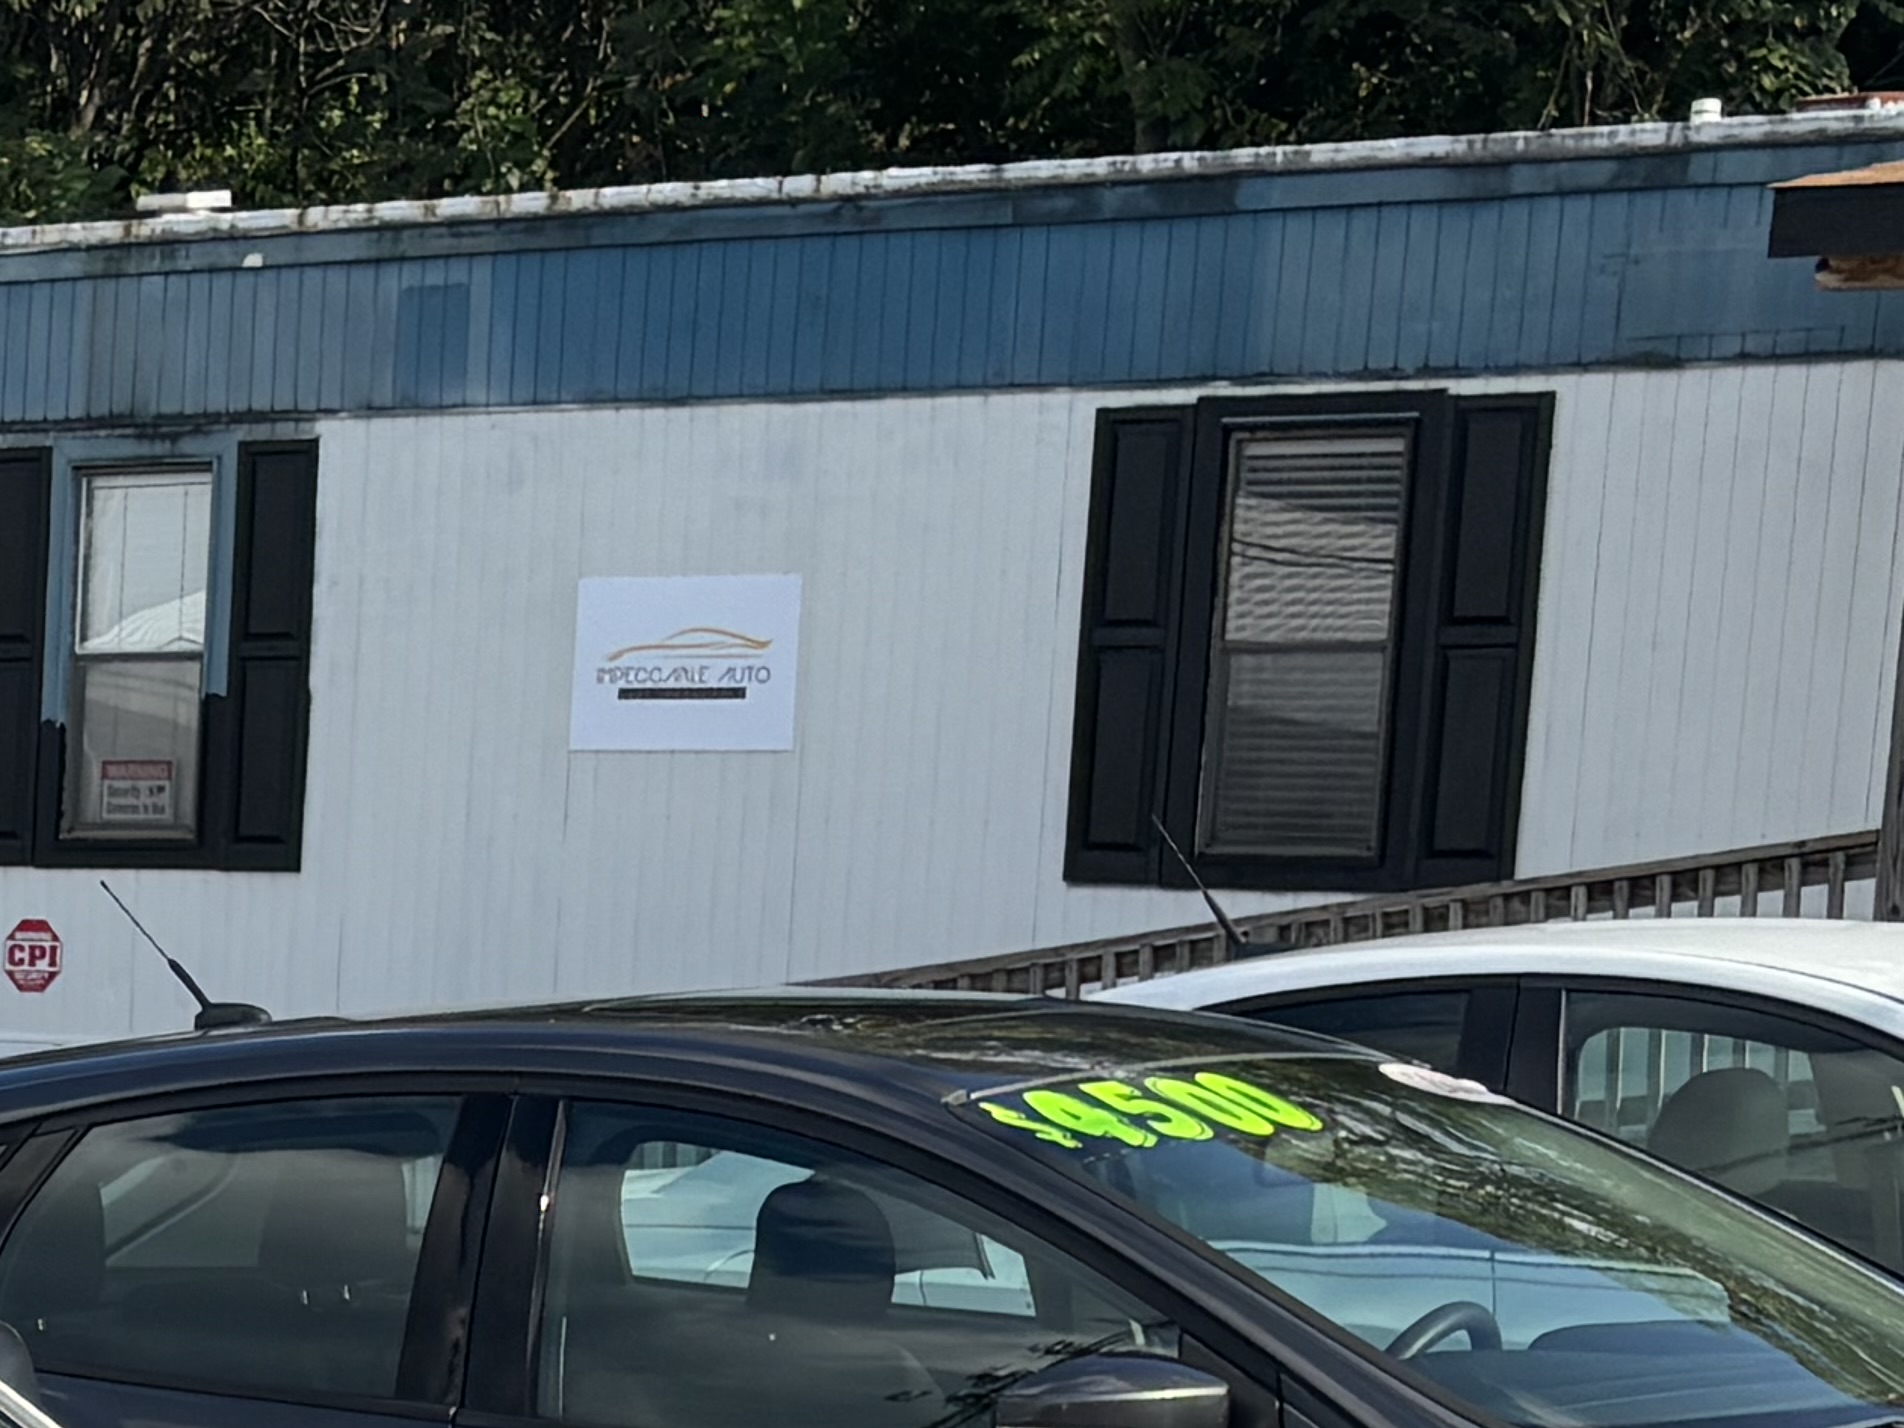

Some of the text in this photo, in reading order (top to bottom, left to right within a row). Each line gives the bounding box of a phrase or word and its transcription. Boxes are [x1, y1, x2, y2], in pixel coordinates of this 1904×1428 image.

[718, 666, 772, 685] AUTO
[8, 944, 58, 968] CPI
[979, 1072, 1322, 1148] $4500
